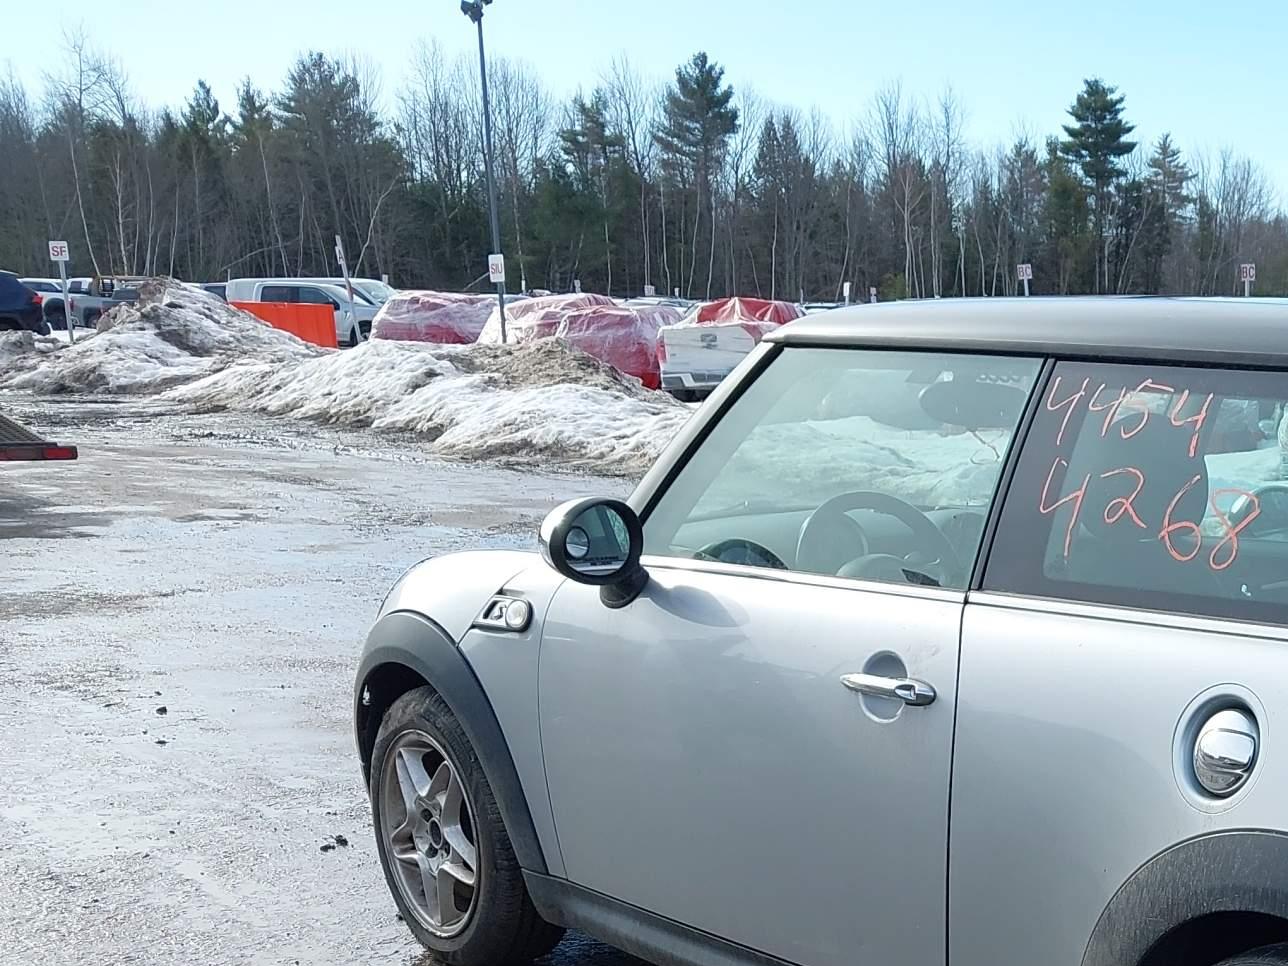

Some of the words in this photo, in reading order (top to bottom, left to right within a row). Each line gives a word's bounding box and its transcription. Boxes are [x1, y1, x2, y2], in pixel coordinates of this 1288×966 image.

[51, 246, 66, 256] SF
[490, 263, 503, 274] SIU
[1242, 266, 1255, 278] BC
[1046, 376, 1214, 458] 4454
[1039, 456, 1261, 570] 4268
